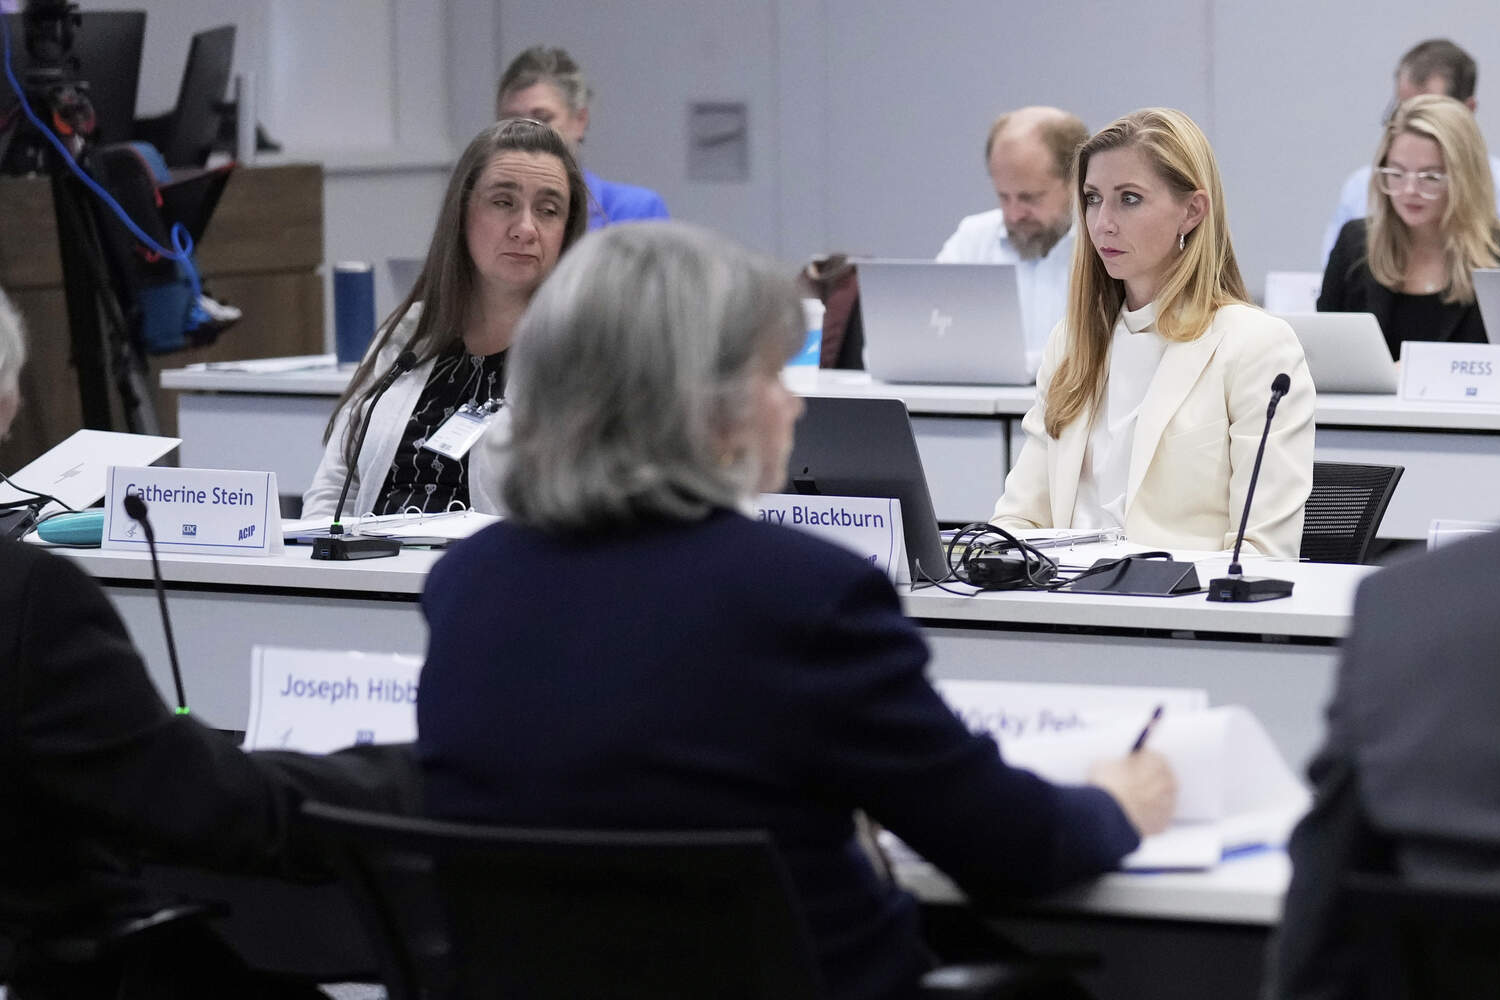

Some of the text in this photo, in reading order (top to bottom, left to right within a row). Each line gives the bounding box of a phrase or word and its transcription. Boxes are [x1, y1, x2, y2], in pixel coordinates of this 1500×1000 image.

[1450, 360, 1493, 376] PRESS
[212, 486, 254, 507] Stein
[757, 505, 884, 529] ary Blackburn
[238, 524, 256, 542] ACIP
[280, 673, 359, 705] Joseph
